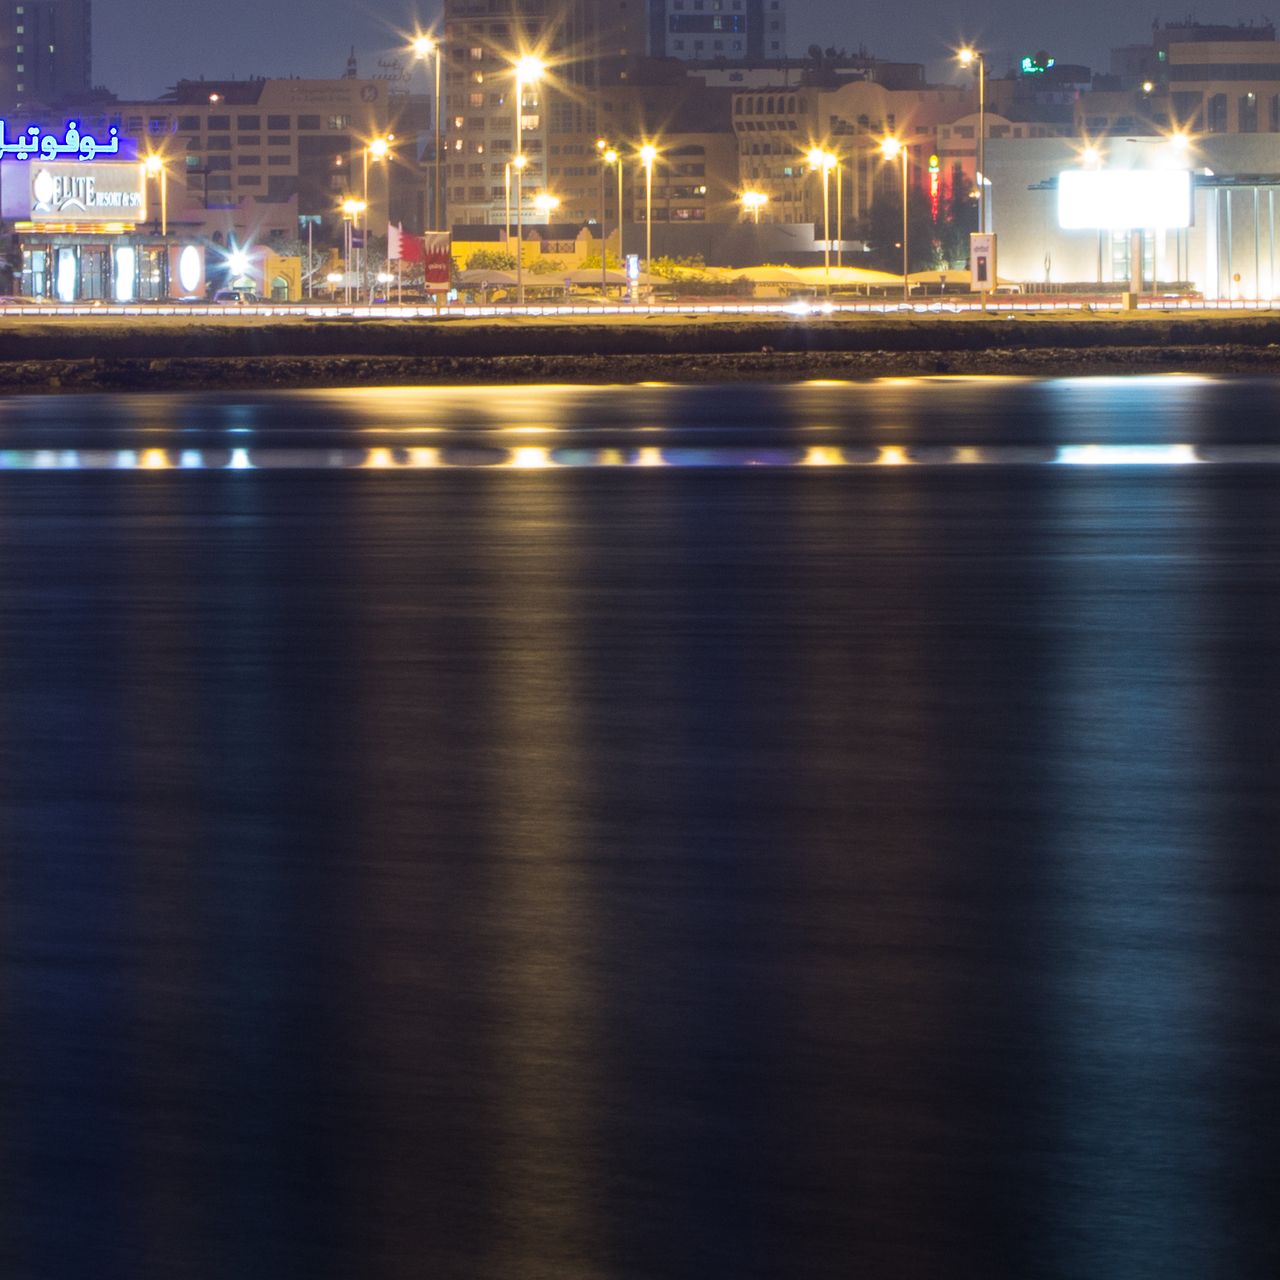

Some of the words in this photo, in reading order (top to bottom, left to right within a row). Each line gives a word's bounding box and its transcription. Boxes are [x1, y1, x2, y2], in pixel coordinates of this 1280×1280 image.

[52, 176, 96, 206] ELITE
[96, 191, 121, 206] RESORT
[122, 192, 130, 206] &
